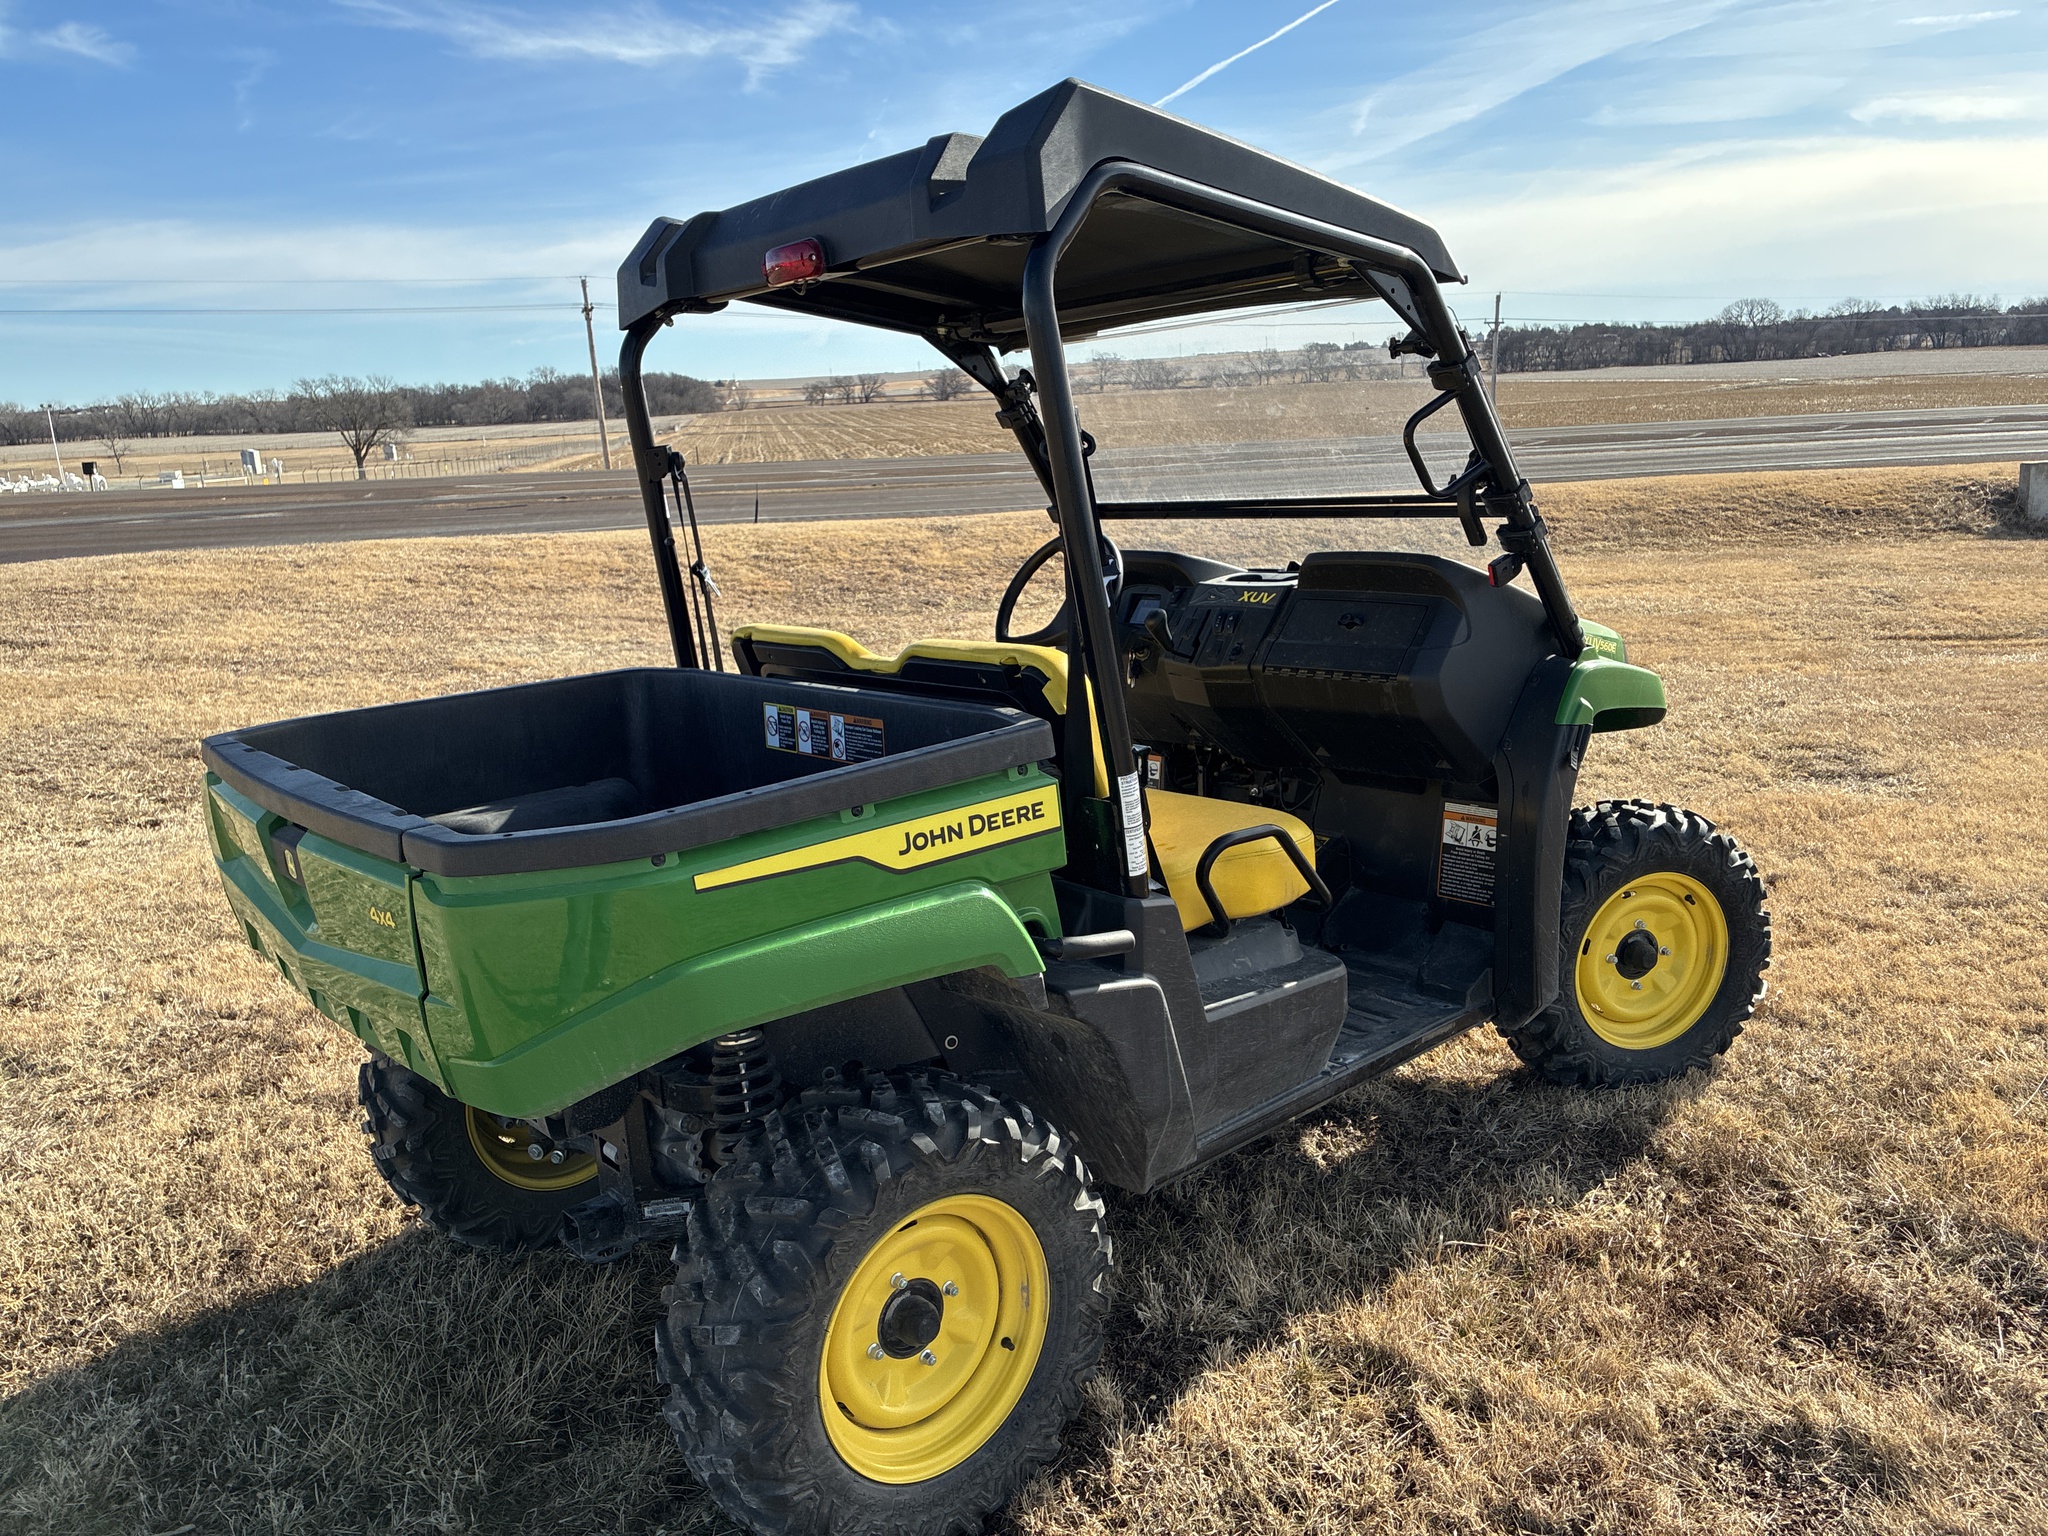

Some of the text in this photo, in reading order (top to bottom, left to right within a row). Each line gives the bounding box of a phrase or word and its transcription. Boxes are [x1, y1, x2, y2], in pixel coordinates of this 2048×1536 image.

[1237, 591, 1277, 604] XUV
[899, 801, 1045, 856] JOHN DEERE
